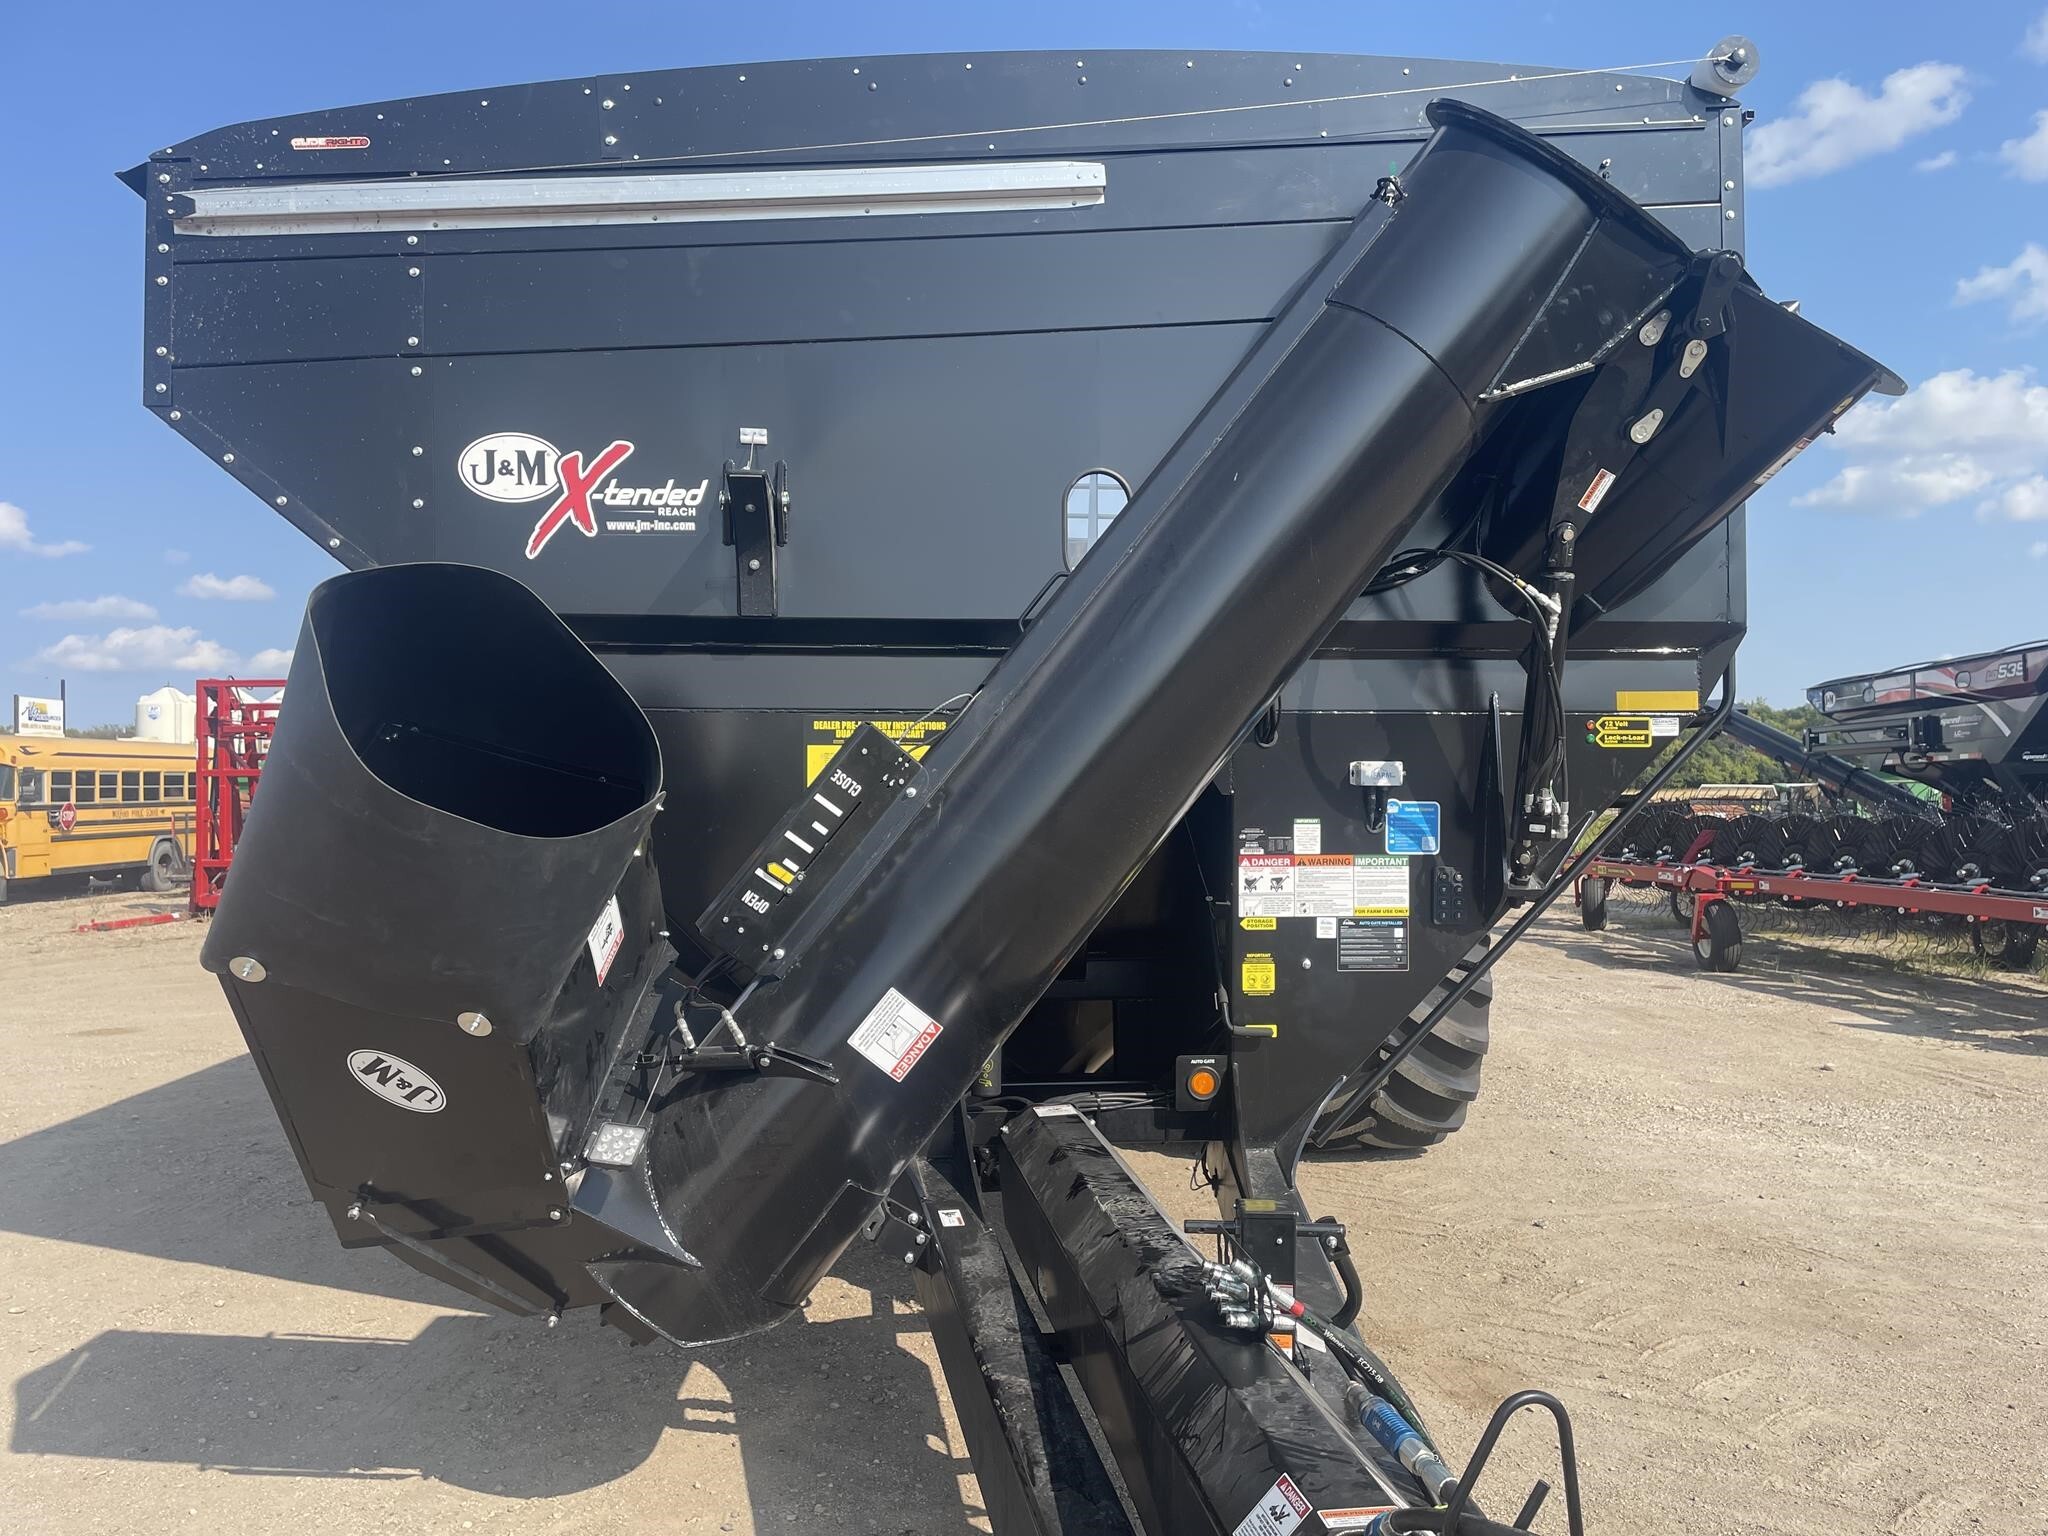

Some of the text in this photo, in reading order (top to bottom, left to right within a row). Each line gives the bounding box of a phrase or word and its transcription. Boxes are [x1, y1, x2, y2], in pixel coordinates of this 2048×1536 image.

[470, 449, 549, 486] J&M
[657, 507, 696, 517] REACH
[606, 519, 696, 533] www.jm-inc.com
[814, 721, 842, 730] DEALER
[1604, 720, 1628, 728] 12 Volt
[830, 768, 862, 797] CLOSE
[62, 811, 75, 821] STOP
[1251, 858, 1291, 866] DANGER
[1308, 858, 1351, 866] WARNING
[1355, 857, 1408, 866] IMPORTANT
[741, 889, 770, 914] OPEN
[892, 1034, 932, 1078] DANGER
[358, 1055, 438, 1105] J&M
[1284, 1485, 1306, 1515] DANGER
